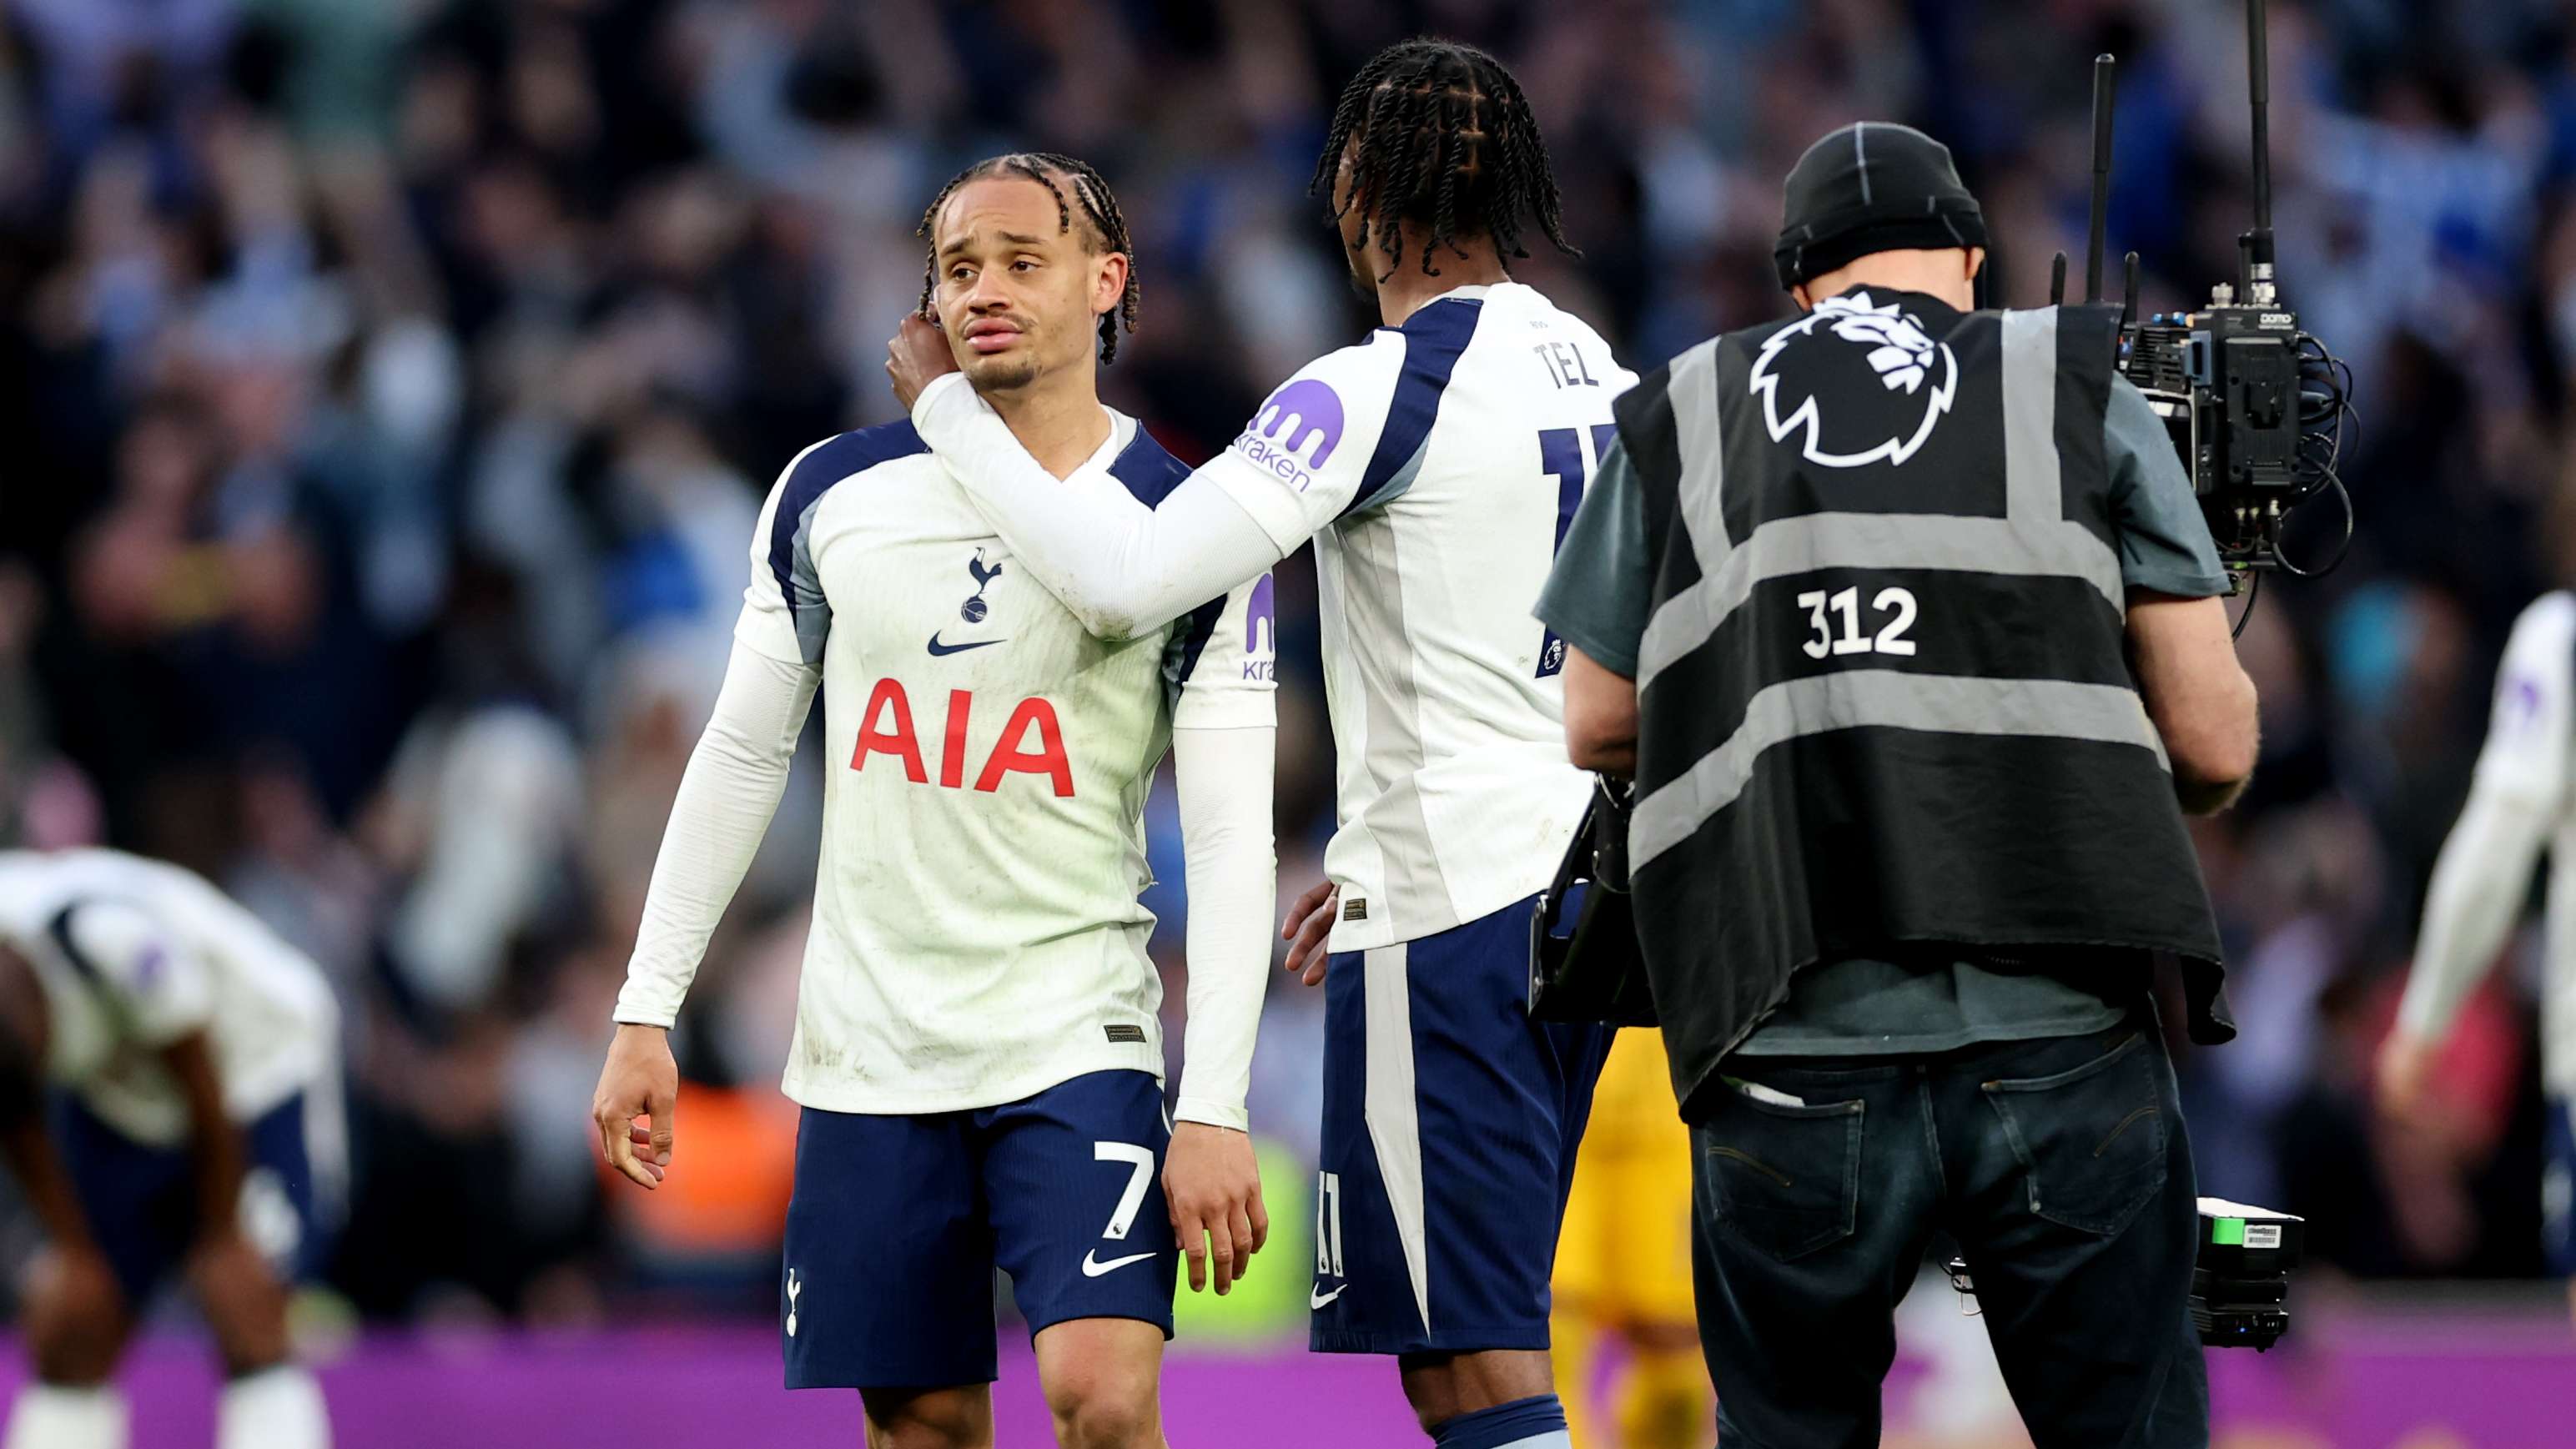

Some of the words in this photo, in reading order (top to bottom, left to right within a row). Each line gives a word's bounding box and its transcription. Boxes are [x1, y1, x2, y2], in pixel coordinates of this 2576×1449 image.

[1533, 342, 1599, 390] TEL
[1235, 434, 1311, 494] kraken
[1798, 586, 1918, 660] 312
[849, 677, 1074, 797] AIA
[1094, 1141, 1155, 1239] 7
